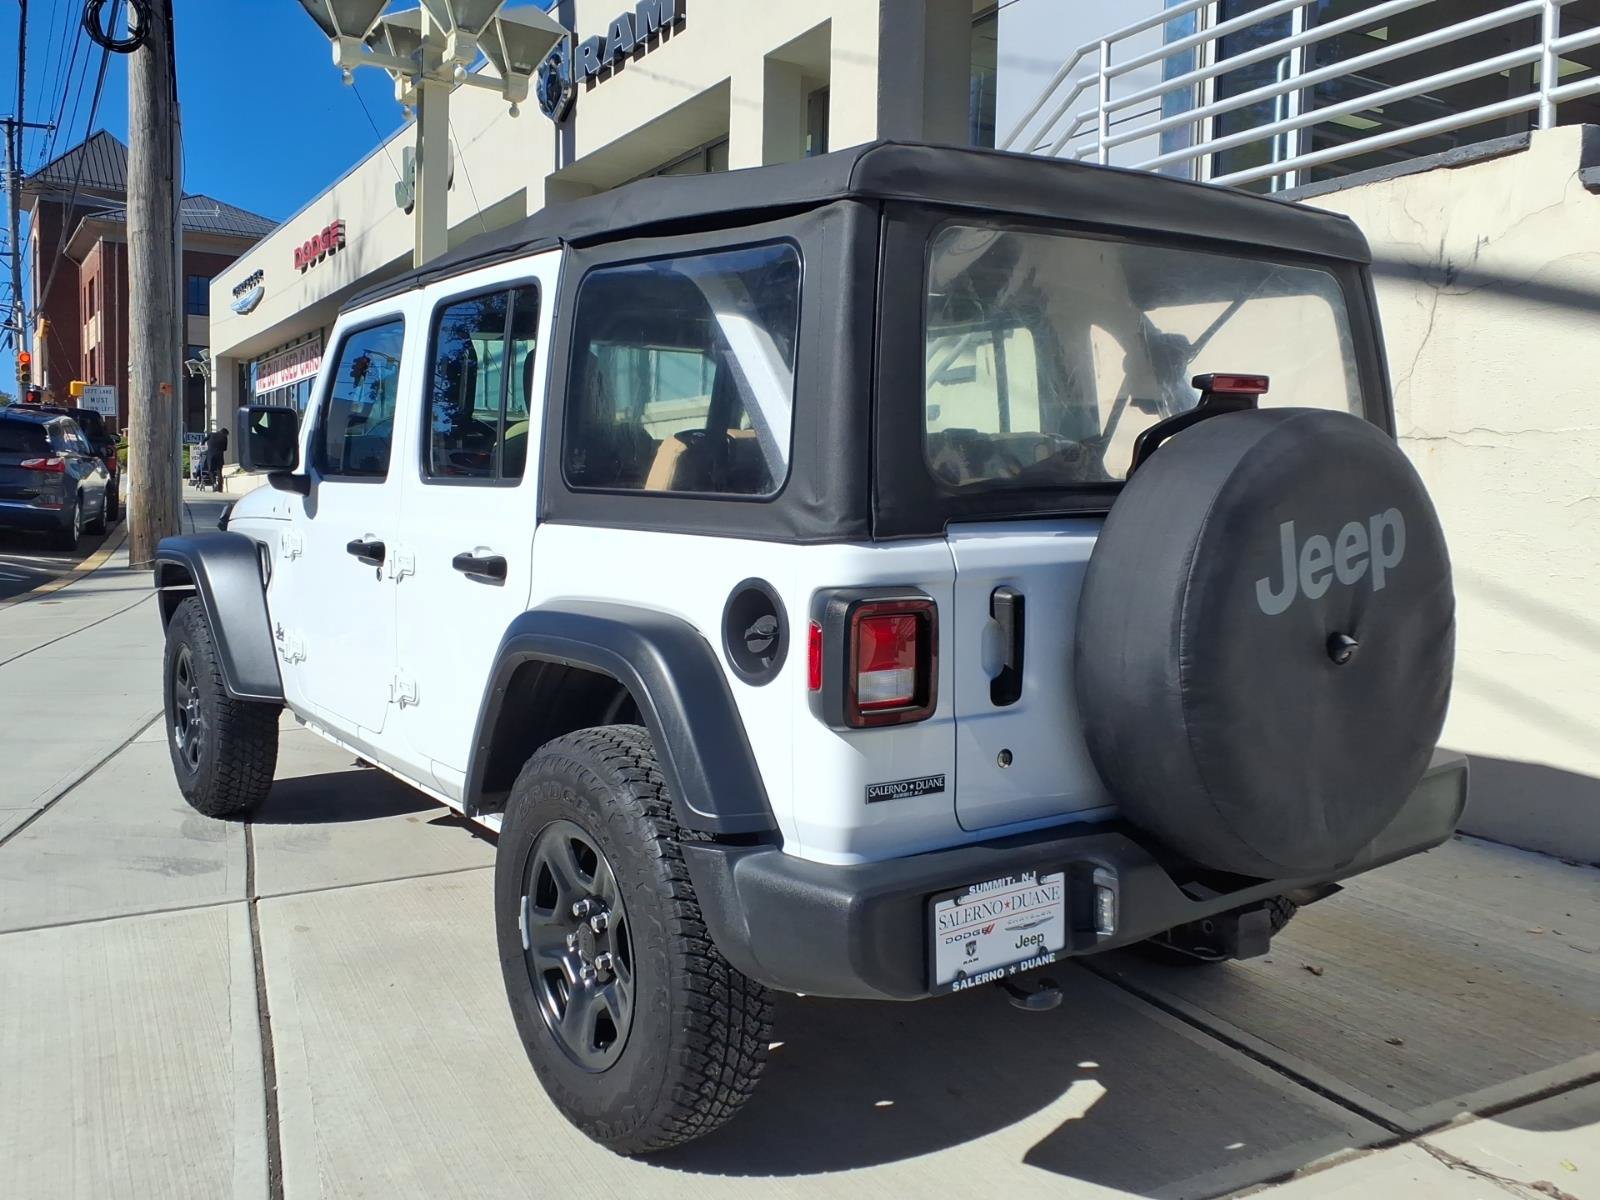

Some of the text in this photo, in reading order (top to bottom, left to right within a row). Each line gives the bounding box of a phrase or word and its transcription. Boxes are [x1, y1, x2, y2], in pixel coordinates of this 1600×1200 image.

[575, 0, 682, 83] RAM
[295, 219, 345, 270] DODGE
[281, 351, 299, 382] USED
[300, 343, 321, 375] CARS
[1256, 508, 1406, 615] Jeep
[869, 778, 944, 797] SALERNO DUANE
[939, 900, 1004, 931] SALERNO
[1011, 886, 1060, 911] DUANE
[1015, 932, 1045, 949] Jeep
[952, 952, 1056, 992] SALERNO DUANE
[963, 957, 979, 965] RAM
